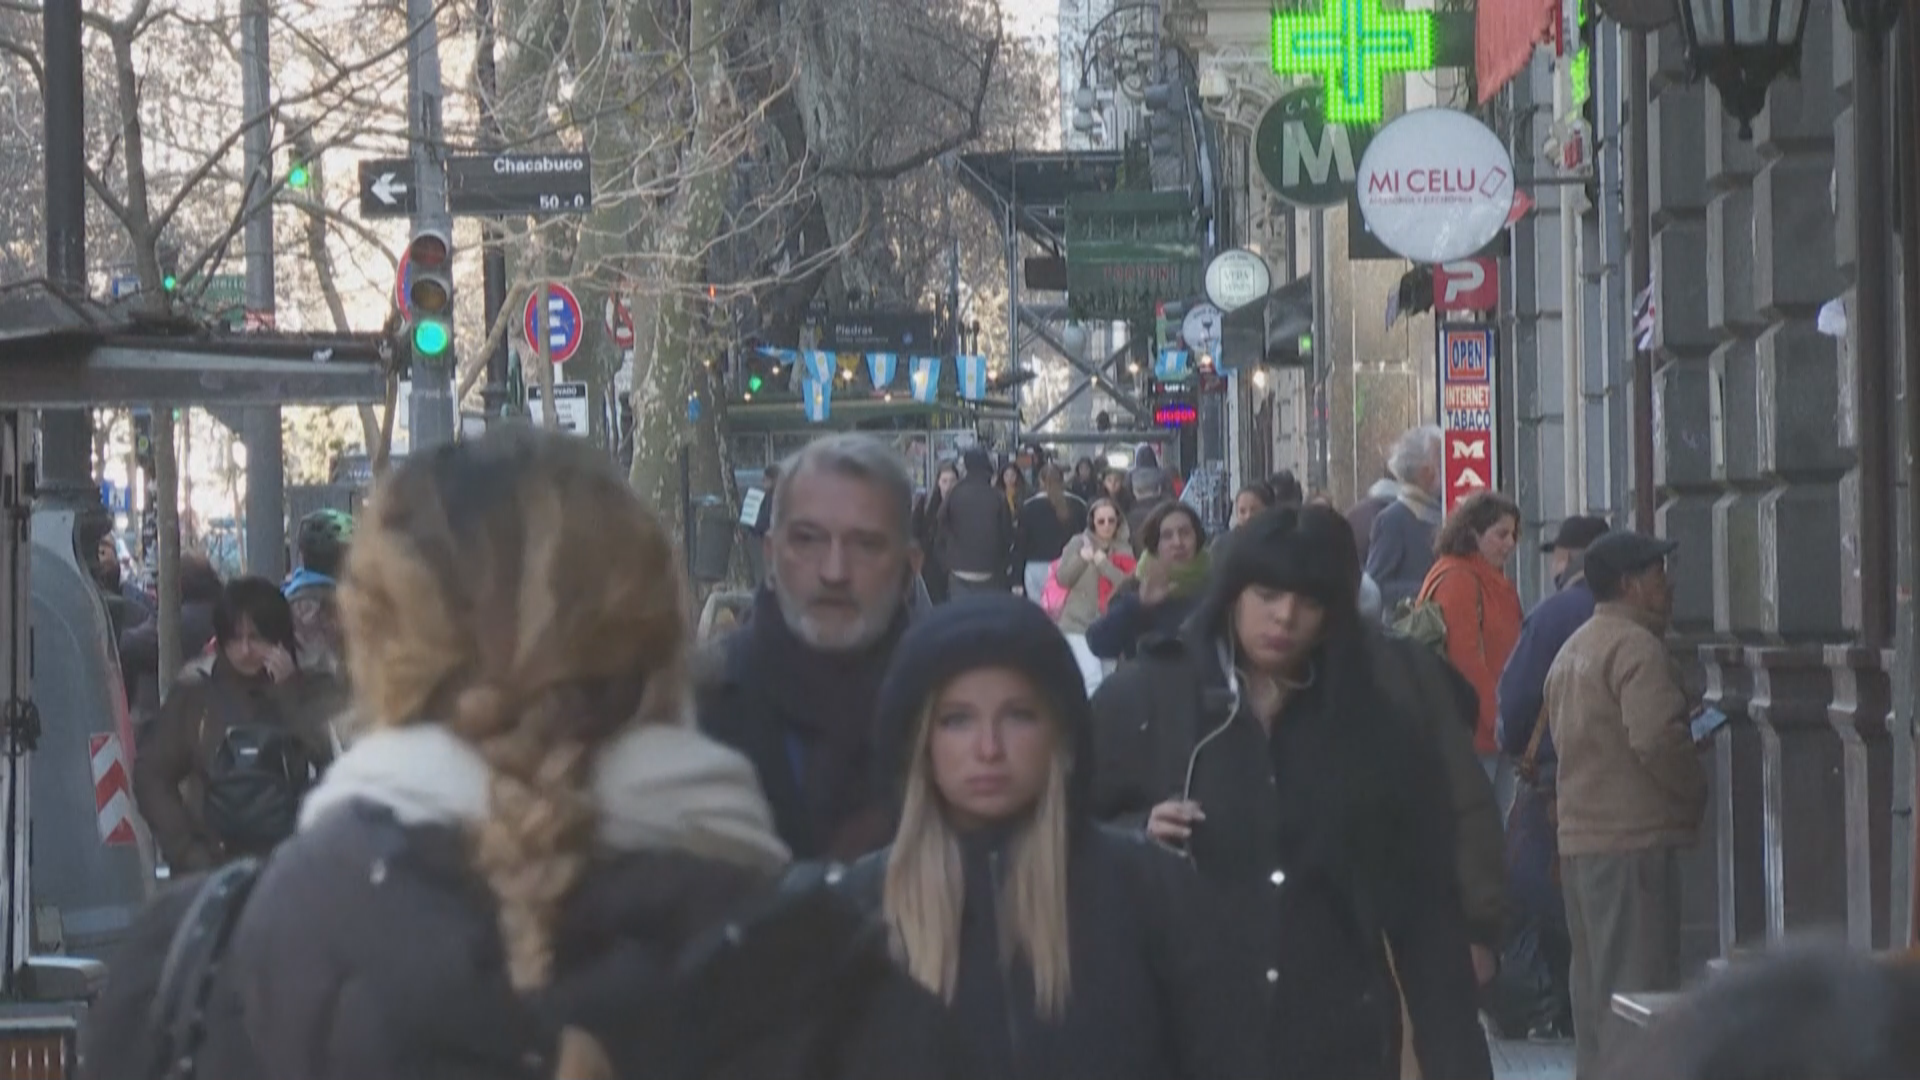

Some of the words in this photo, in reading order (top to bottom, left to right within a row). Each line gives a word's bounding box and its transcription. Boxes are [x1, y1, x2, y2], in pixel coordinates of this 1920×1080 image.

[493, 156, 584, 173] Chacabuco
[1282, 120, 1356, 188] M
[1368, 168, 1400, 194] MI
[1406, 166, 1476, 194] CELU
[540, 194, 560, 210] 50
[574, 192, 585, 208] 0
[1452, 339, 1483, 369] OPEN
[1445, 384, 1490, 408] INTERNET
[1447, 410, 1491, 430] TABACO
